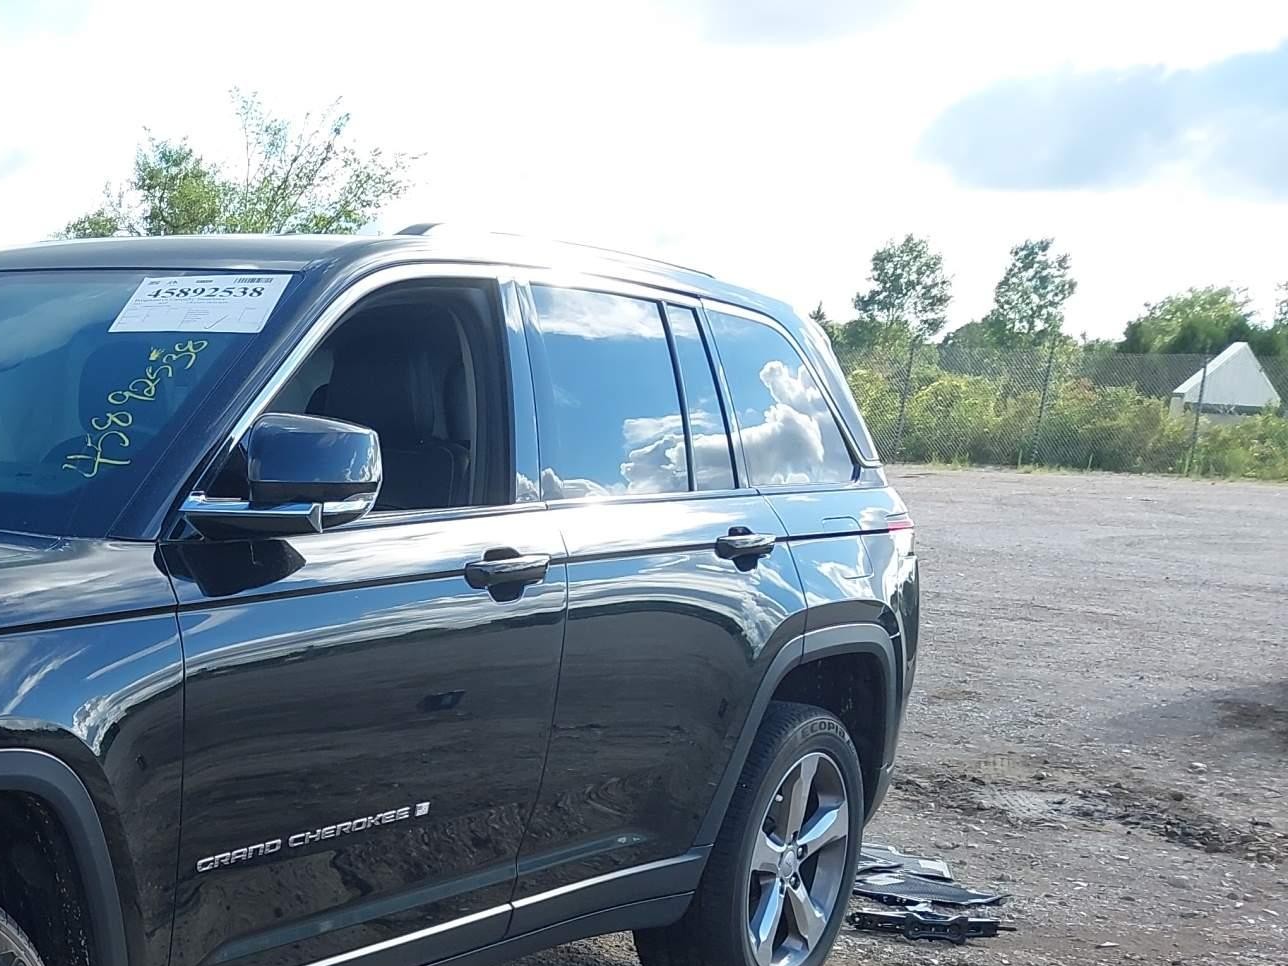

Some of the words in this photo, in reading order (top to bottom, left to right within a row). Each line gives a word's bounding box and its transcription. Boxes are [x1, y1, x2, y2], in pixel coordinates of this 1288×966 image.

[147, 286, 265, 299] 45892538
[62, 339, 209, 479] 45892538
[196, 838, 282, 873] GRAND
[288, 806, 411, 849] CHEROKEE
